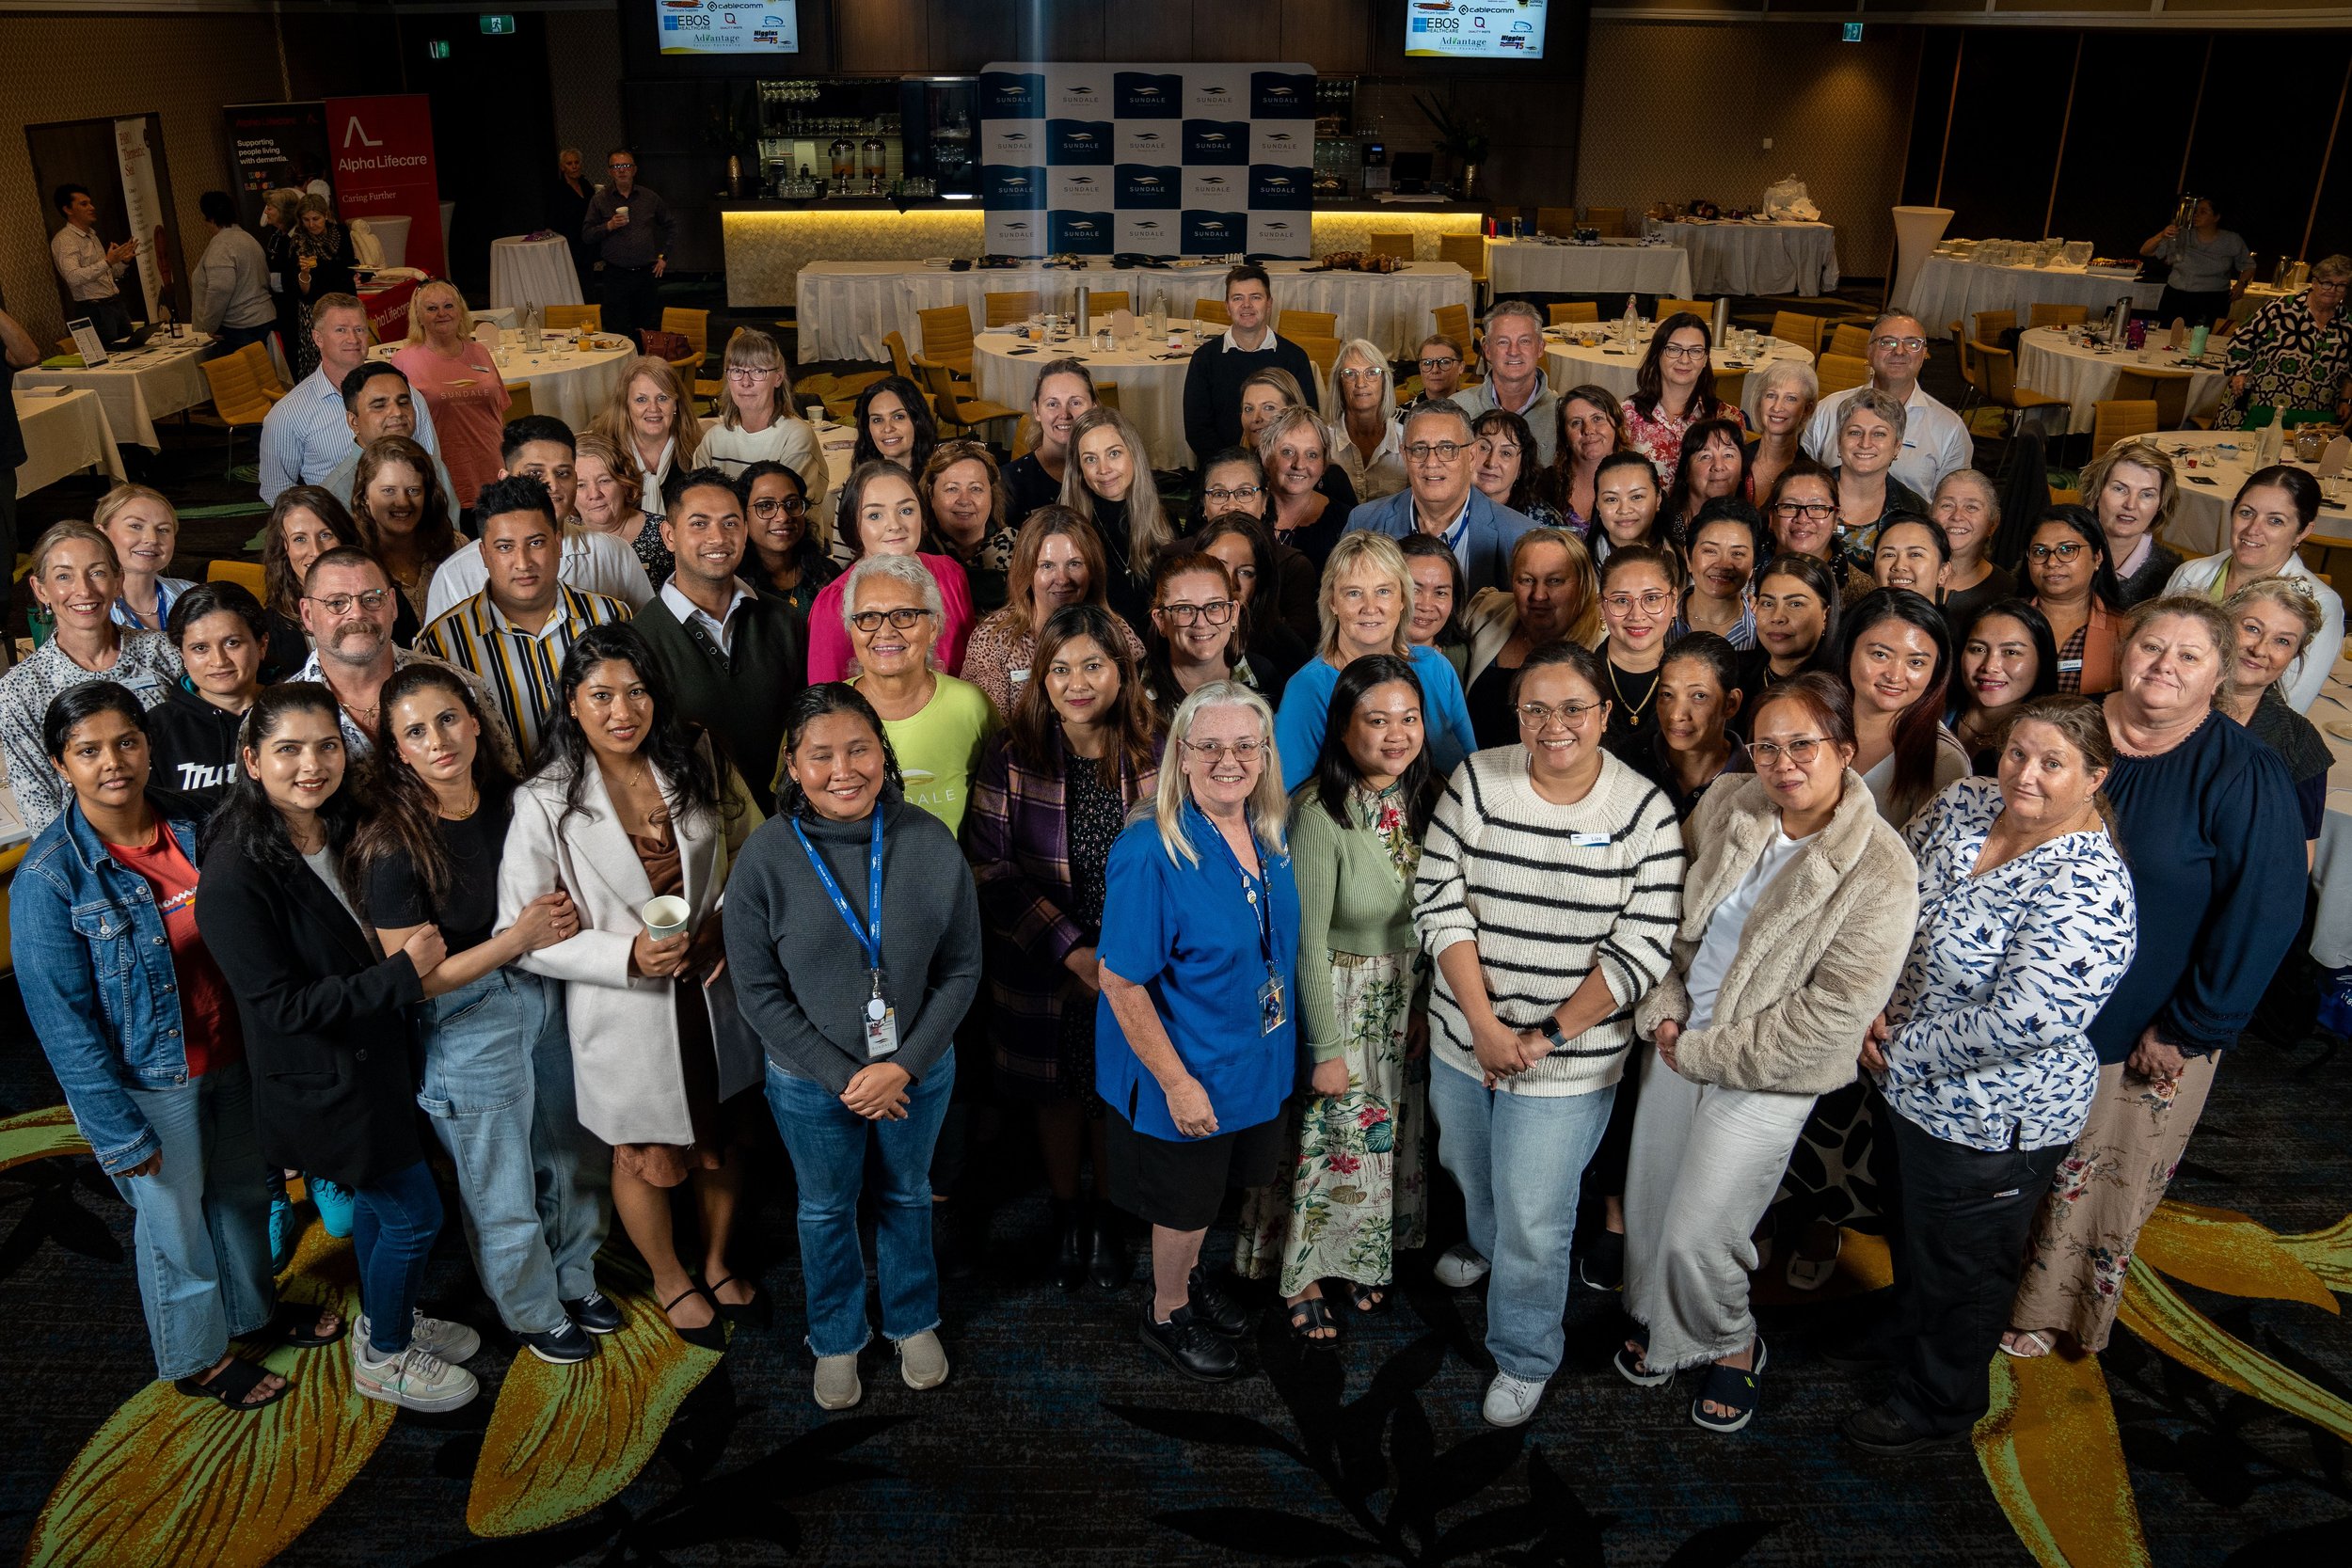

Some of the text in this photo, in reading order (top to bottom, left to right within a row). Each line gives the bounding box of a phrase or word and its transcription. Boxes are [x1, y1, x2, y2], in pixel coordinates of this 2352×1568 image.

[677, 15, 710, 25] EBOS
[1427, 18, 1459, 29] EBOS
[237, 138, 275, 147] Supporting
[238, 147, 280, 156] people living
[240, 155, 289, 165] with dementia.
[339, 154, 427, 172] Alpha Lifecare
[342, 191, 397, 203] Caring Further
[440, 388, 490, 400] SUNDALE
